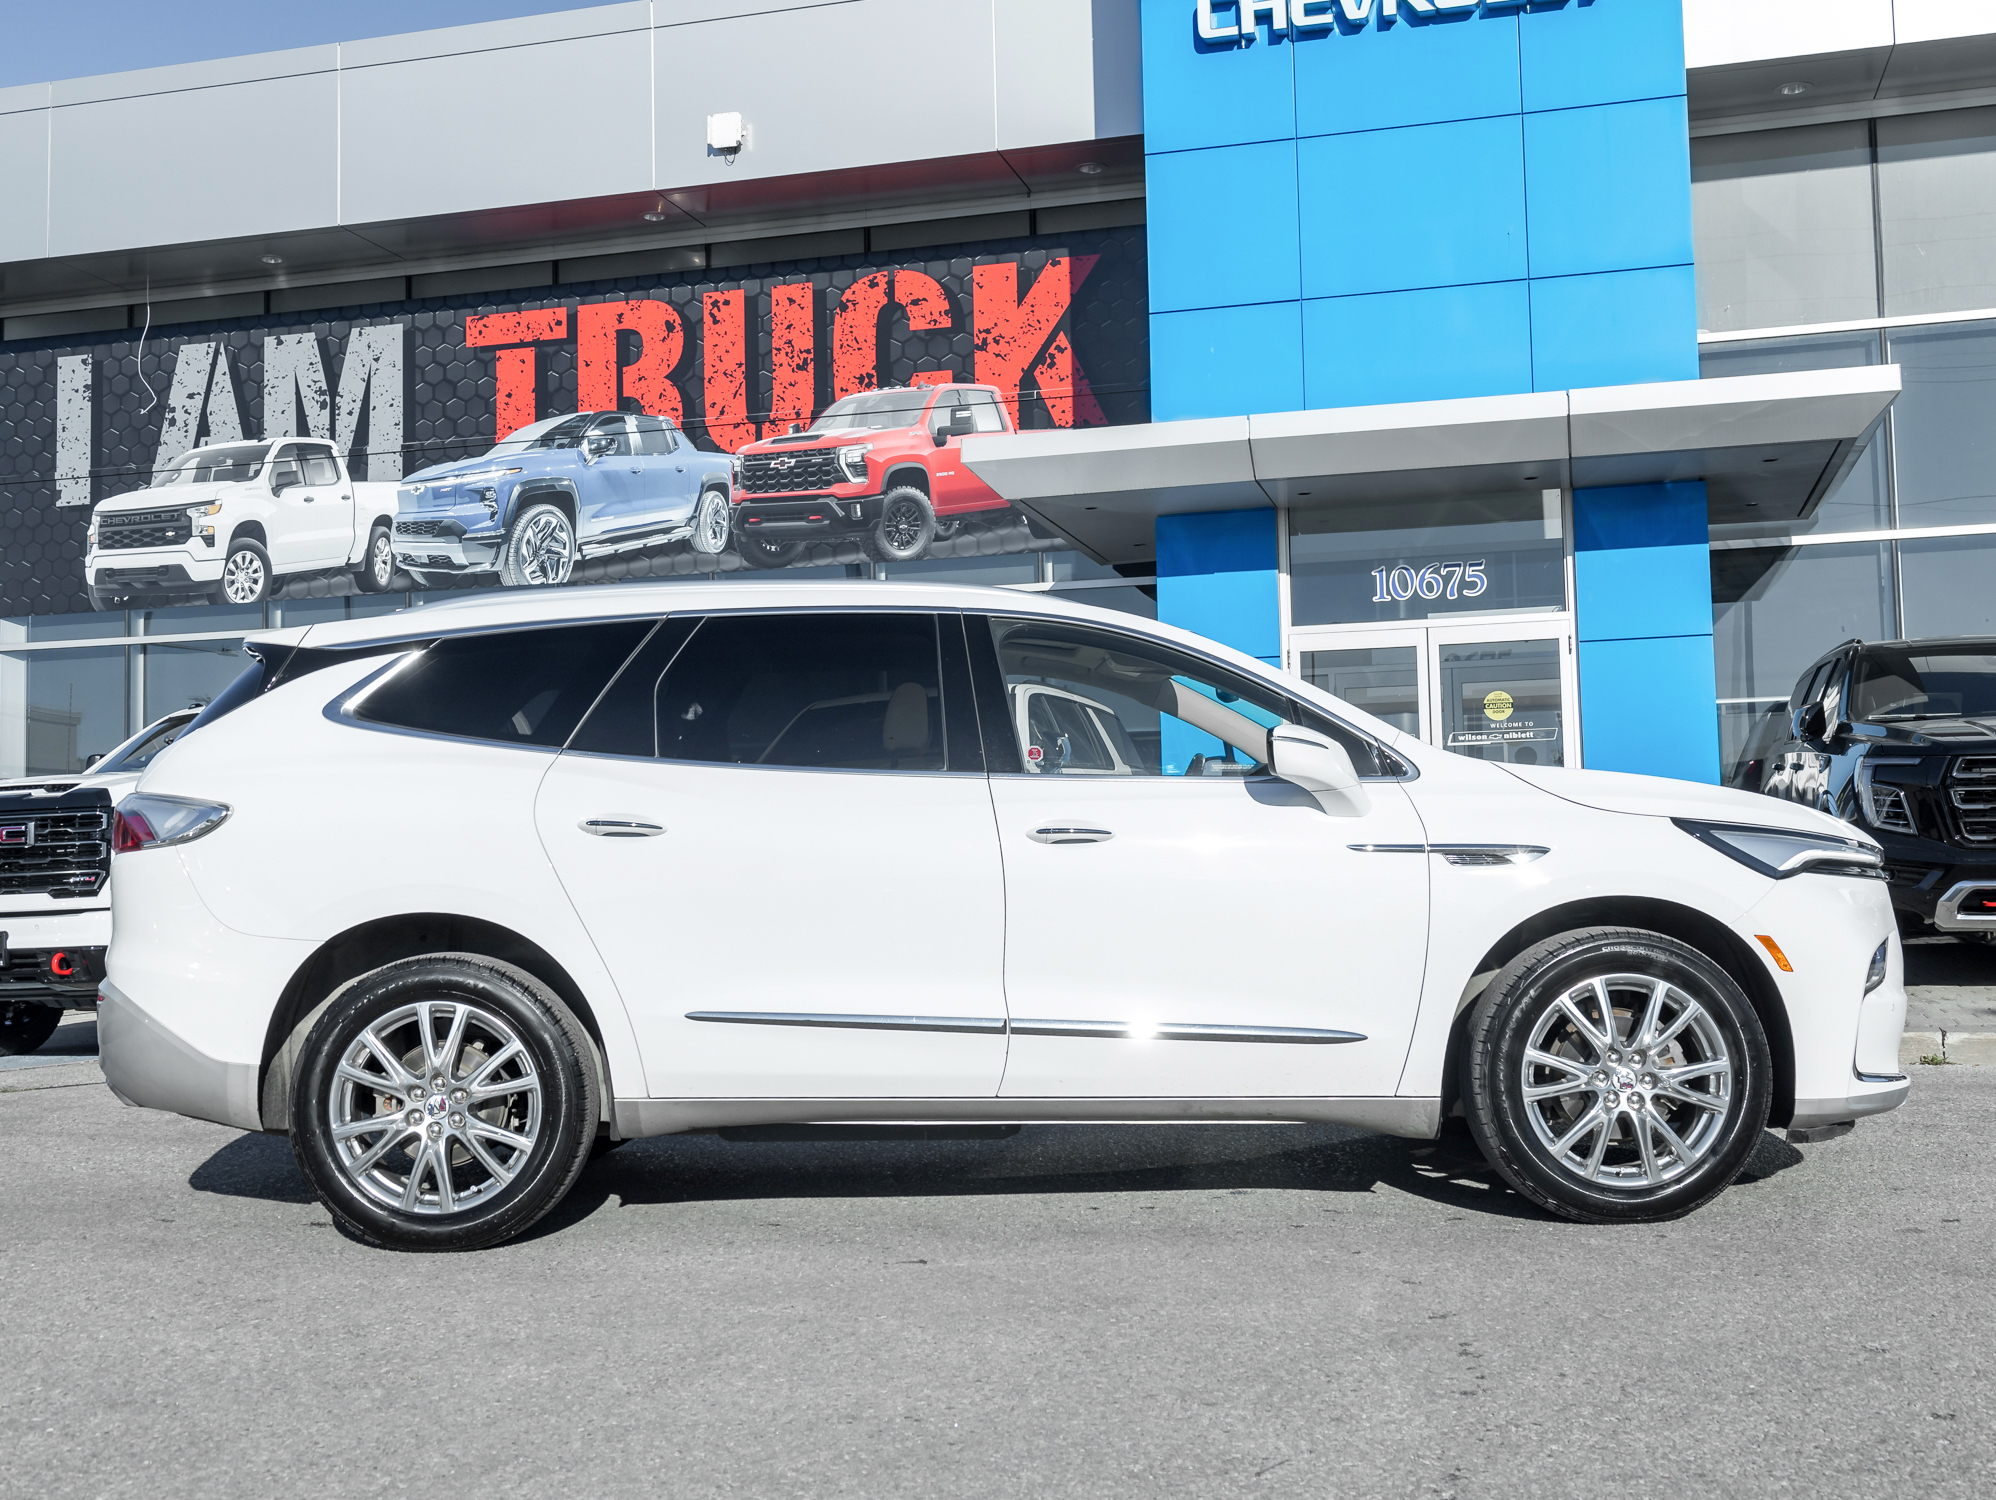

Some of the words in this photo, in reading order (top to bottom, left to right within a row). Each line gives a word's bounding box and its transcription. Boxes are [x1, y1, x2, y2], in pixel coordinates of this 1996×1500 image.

[150, 323, 404, 489] AM
[465, 254, 1106, 455] TRUCK
[101, 512, 181, 525] CHEVROLET
[1371, 559, 1488, 602] 10675
[1458, 733, 1488, 741] wilson
[1503, 731, 1534, 739] niblett
